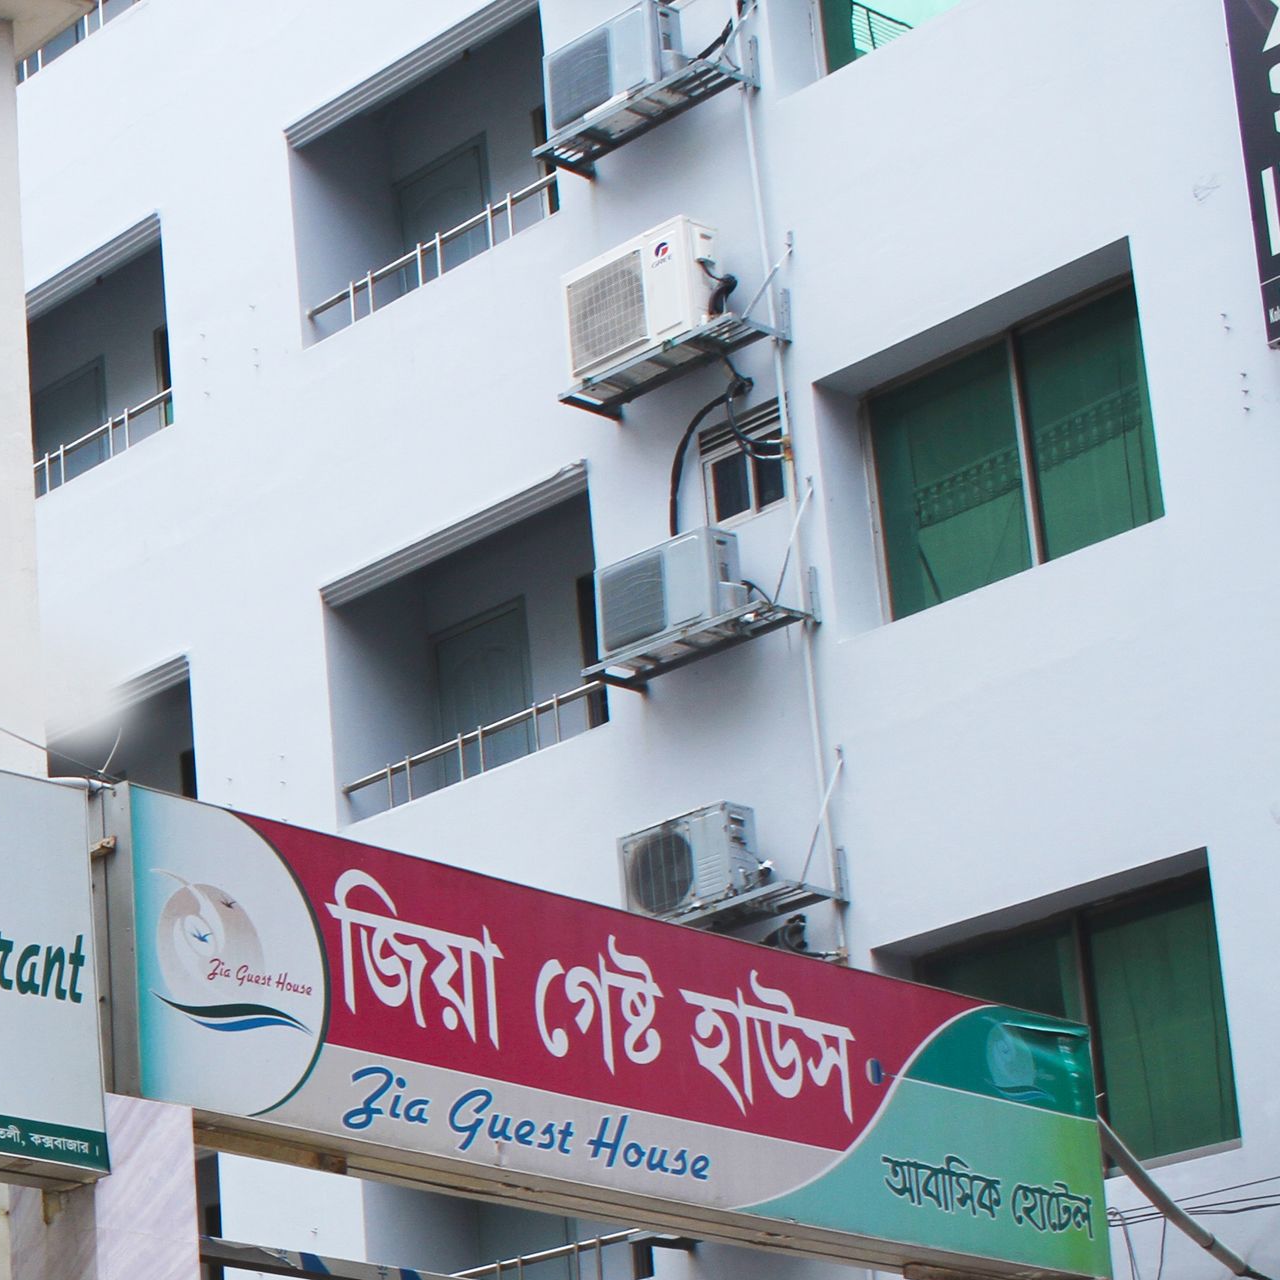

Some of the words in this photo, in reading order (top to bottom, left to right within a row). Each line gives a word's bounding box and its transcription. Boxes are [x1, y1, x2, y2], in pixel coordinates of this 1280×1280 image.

[207, 958, 231, 980] Zia
[236, 965, 273, 986] Guest
[275, 973, 313, 996] House
[325, 869, 505, 1050] জিয়া
[680, 970, 856, 1124] হাউস
[341, 1065, 431, 1130] Zia
[448, 1089, 575, 1152] Guest
[588, 1114, 711, 1181] House
[881, 1154, 1001, 1218] আবাসিক
[1011, 1181, 1095, 1241] হোটেল
